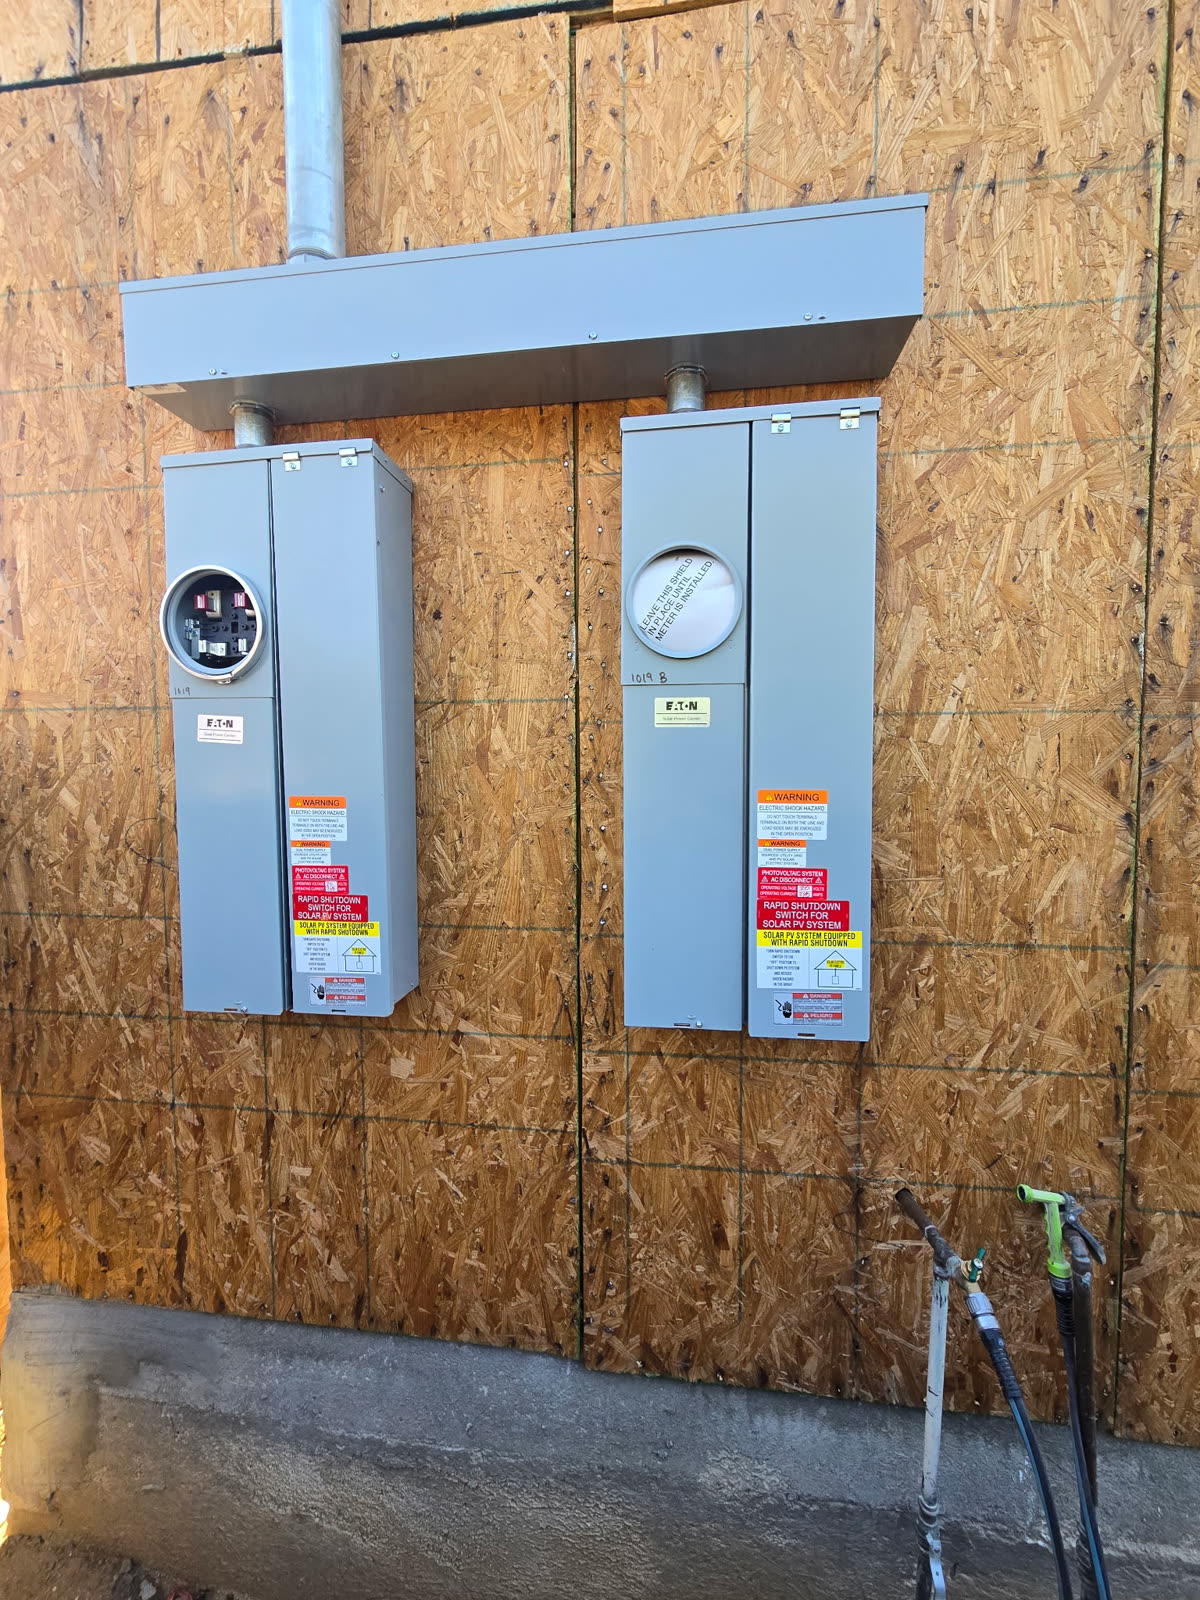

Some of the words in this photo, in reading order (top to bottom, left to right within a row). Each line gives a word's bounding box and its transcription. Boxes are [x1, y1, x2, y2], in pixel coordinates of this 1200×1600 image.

[639, 603, 661, 630] LEAVE
[656, 584, 673, 603] THIS
[670, 558, 693, 585] SHIELD
[647, 625, 657, 636] IN
[653, 598, 675, 626] PLACE
[671, 576, 692, 598] UNTIL
[655, 612, 678, 641] METER
[674, 602, 684, 612] IS
[680, 561, 715, 602] INSTALLED.
[631, 672, 653, 683] 1019
[659, 671, 668, 683] B
[174, 686, 191, 696] 1019
[774, 793, 820, 801] WARNING
[298, 895, 319, 903] RAPID
[320, 896, 361, 904] SHUTDOWN
[308, 904, 335, 912] SWITCH
[336, 904, 351, 912] FOR
[764, 901, 789, 910] RAPID
[791, 902, 841, 911] SHUTDOWN
[321, 912, 332, 920] PV
[333, 913, 362, 921] SYSTEM
[775, 911, 808, 920] SWITCH
[810, 911, 829, 920] FOR
[762, 920, 791, 928] SOLAR
[806, 921, 842, 930] SYSTEM
[763, 932, 784, 940] SOLAR
[786, 932, 795, 940] PV
[796, 932, 822, 940] SYSTEM
[824, 932, 856, 940] EQUIPPED
